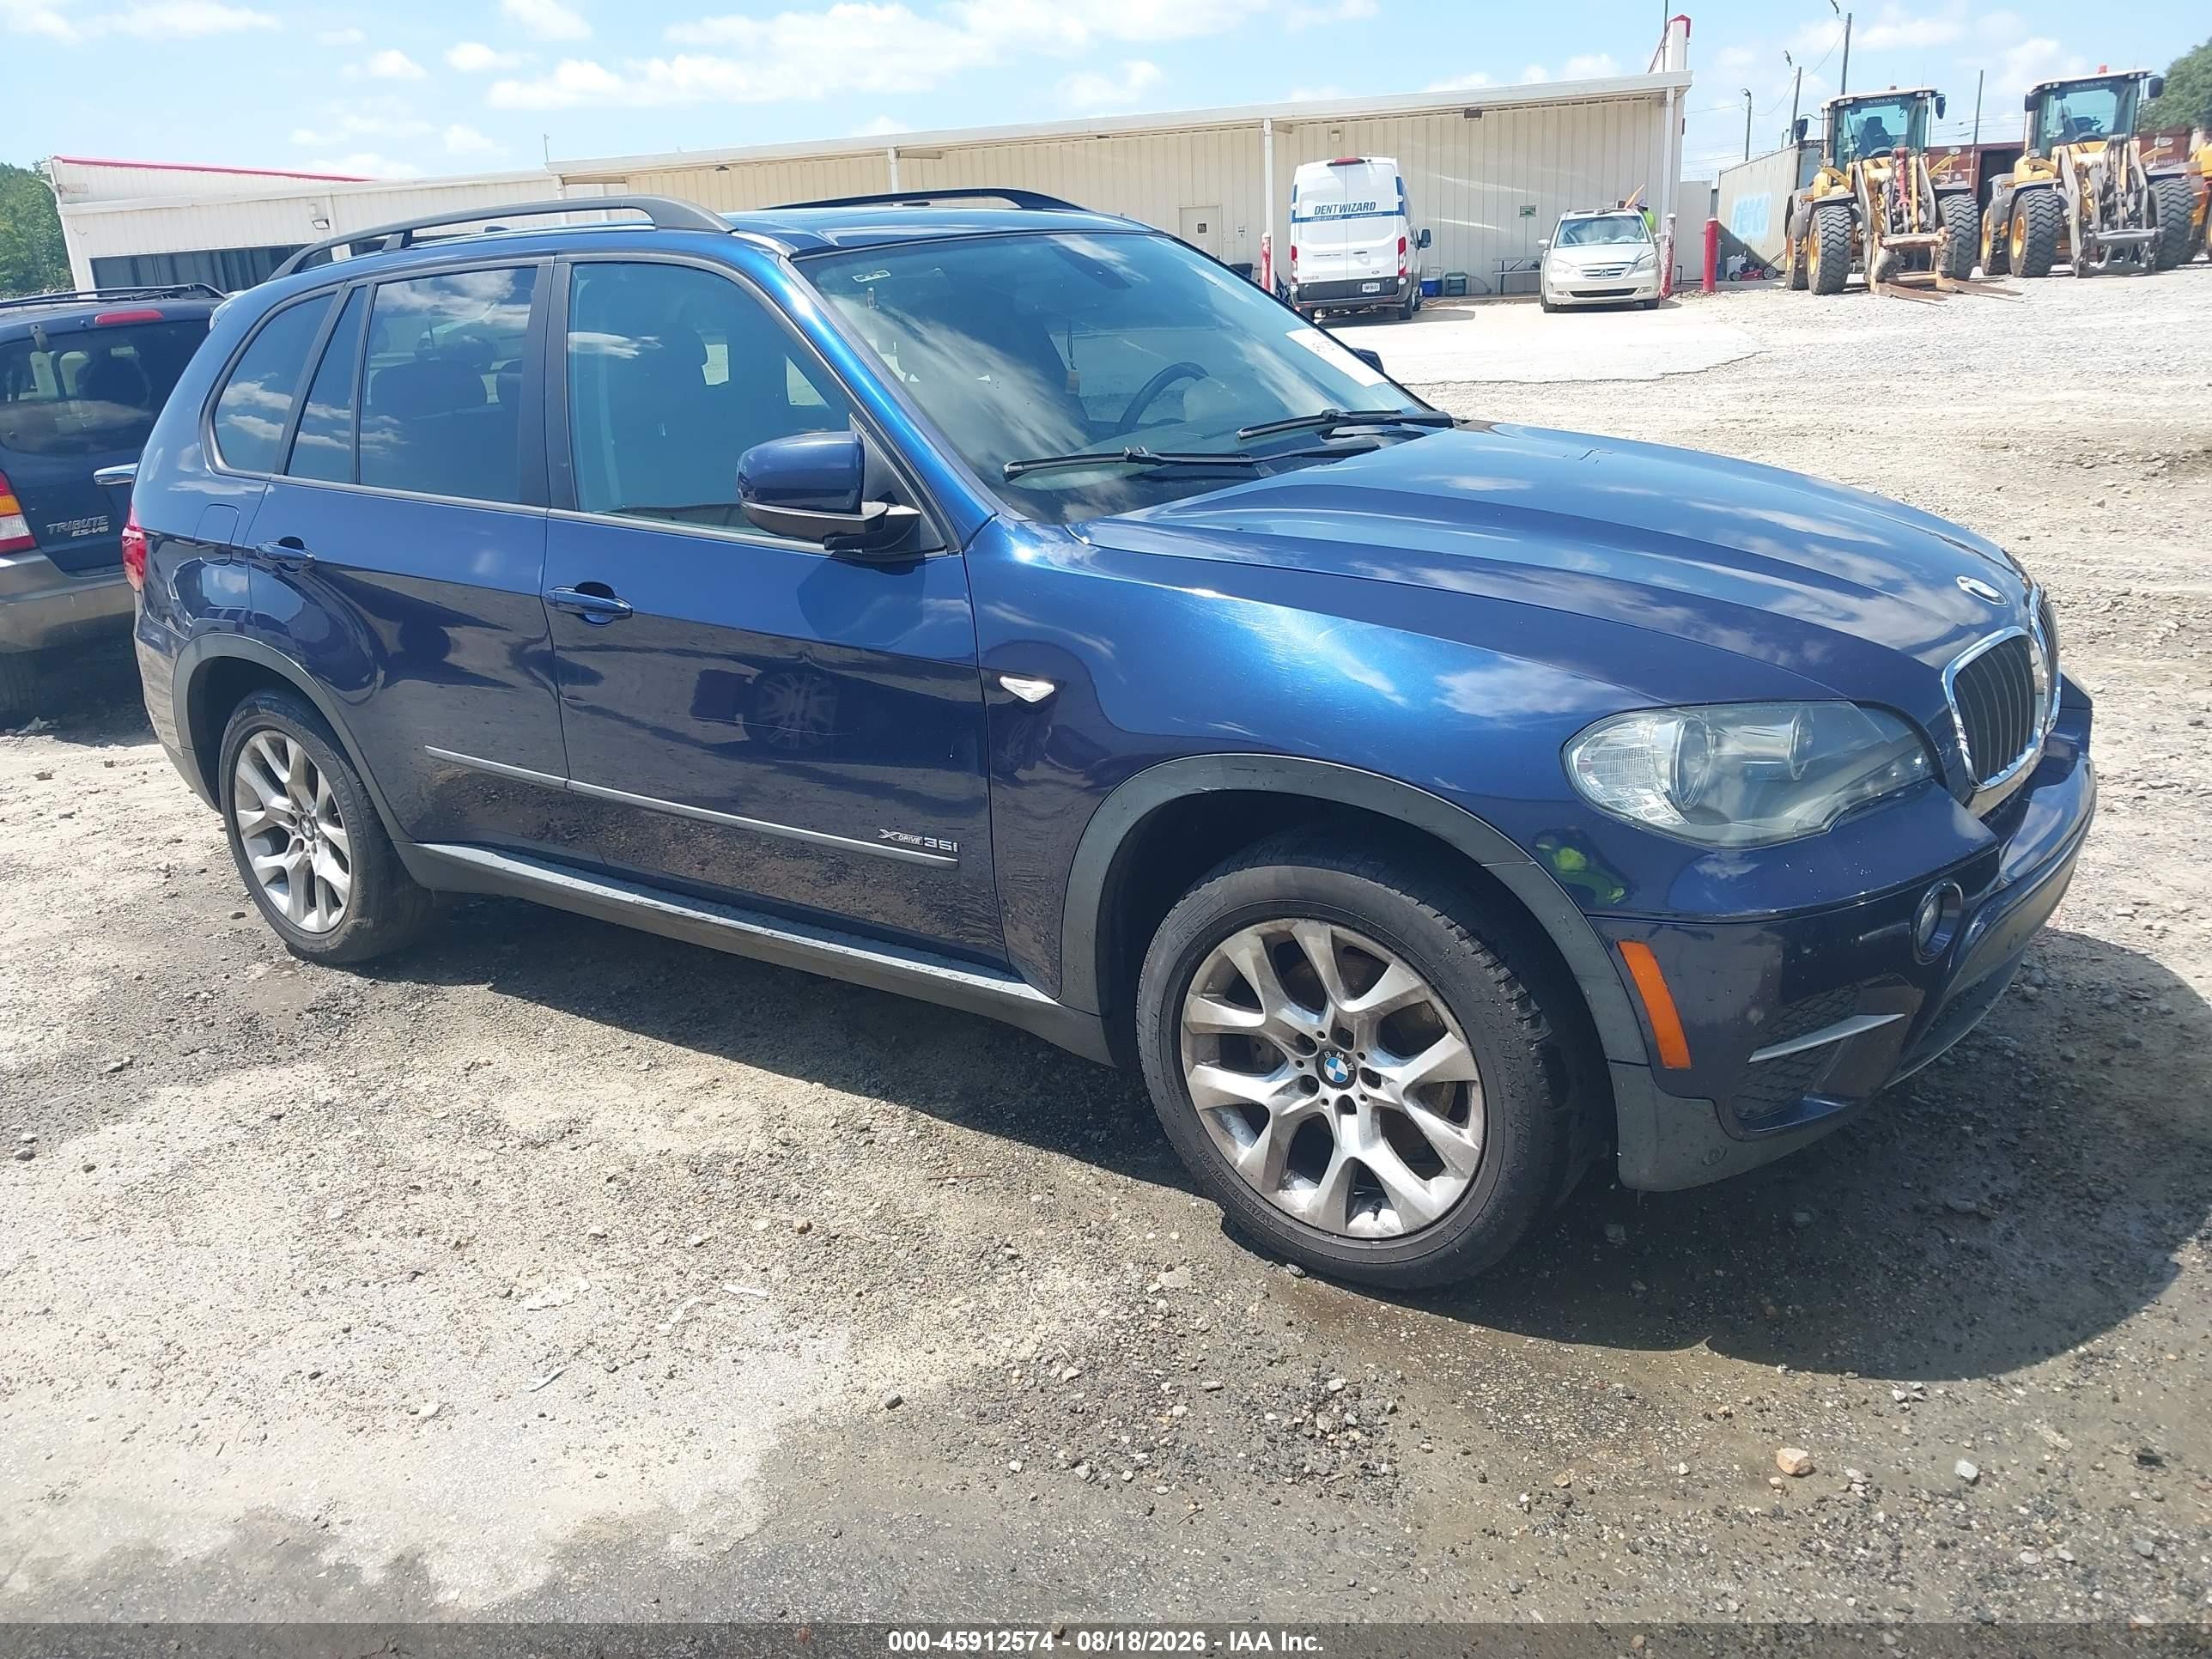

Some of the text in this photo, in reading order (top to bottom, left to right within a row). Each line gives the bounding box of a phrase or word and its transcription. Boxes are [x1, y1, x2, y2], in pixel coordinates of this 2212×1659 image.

[1314, 204, 1339, 216] DENT
[1339, 201, 1376, 214] WIZARD
[46, 515, 108, 535] TRIBUTE
[70, 525, 109, 538] ES-V6
[1323, 1050, 1355, 1071] BMW
